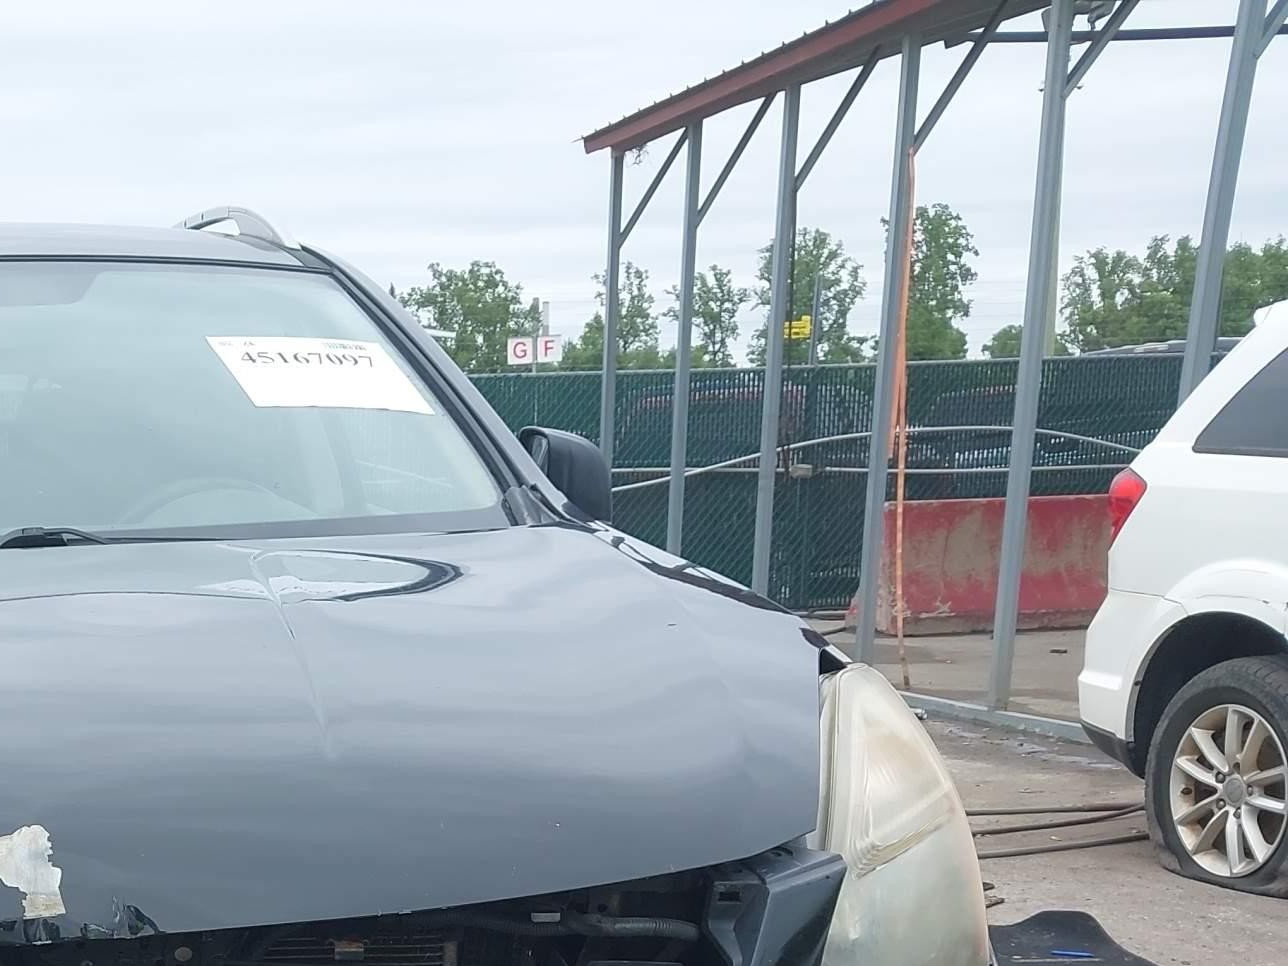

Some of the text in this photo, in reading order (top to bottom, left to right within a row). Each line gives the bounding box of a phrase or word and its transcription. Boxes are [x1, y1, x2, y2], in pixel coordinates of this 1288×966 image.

[513, 340, 555, 359] G F
[240, 351, 374, 368] 45167097
